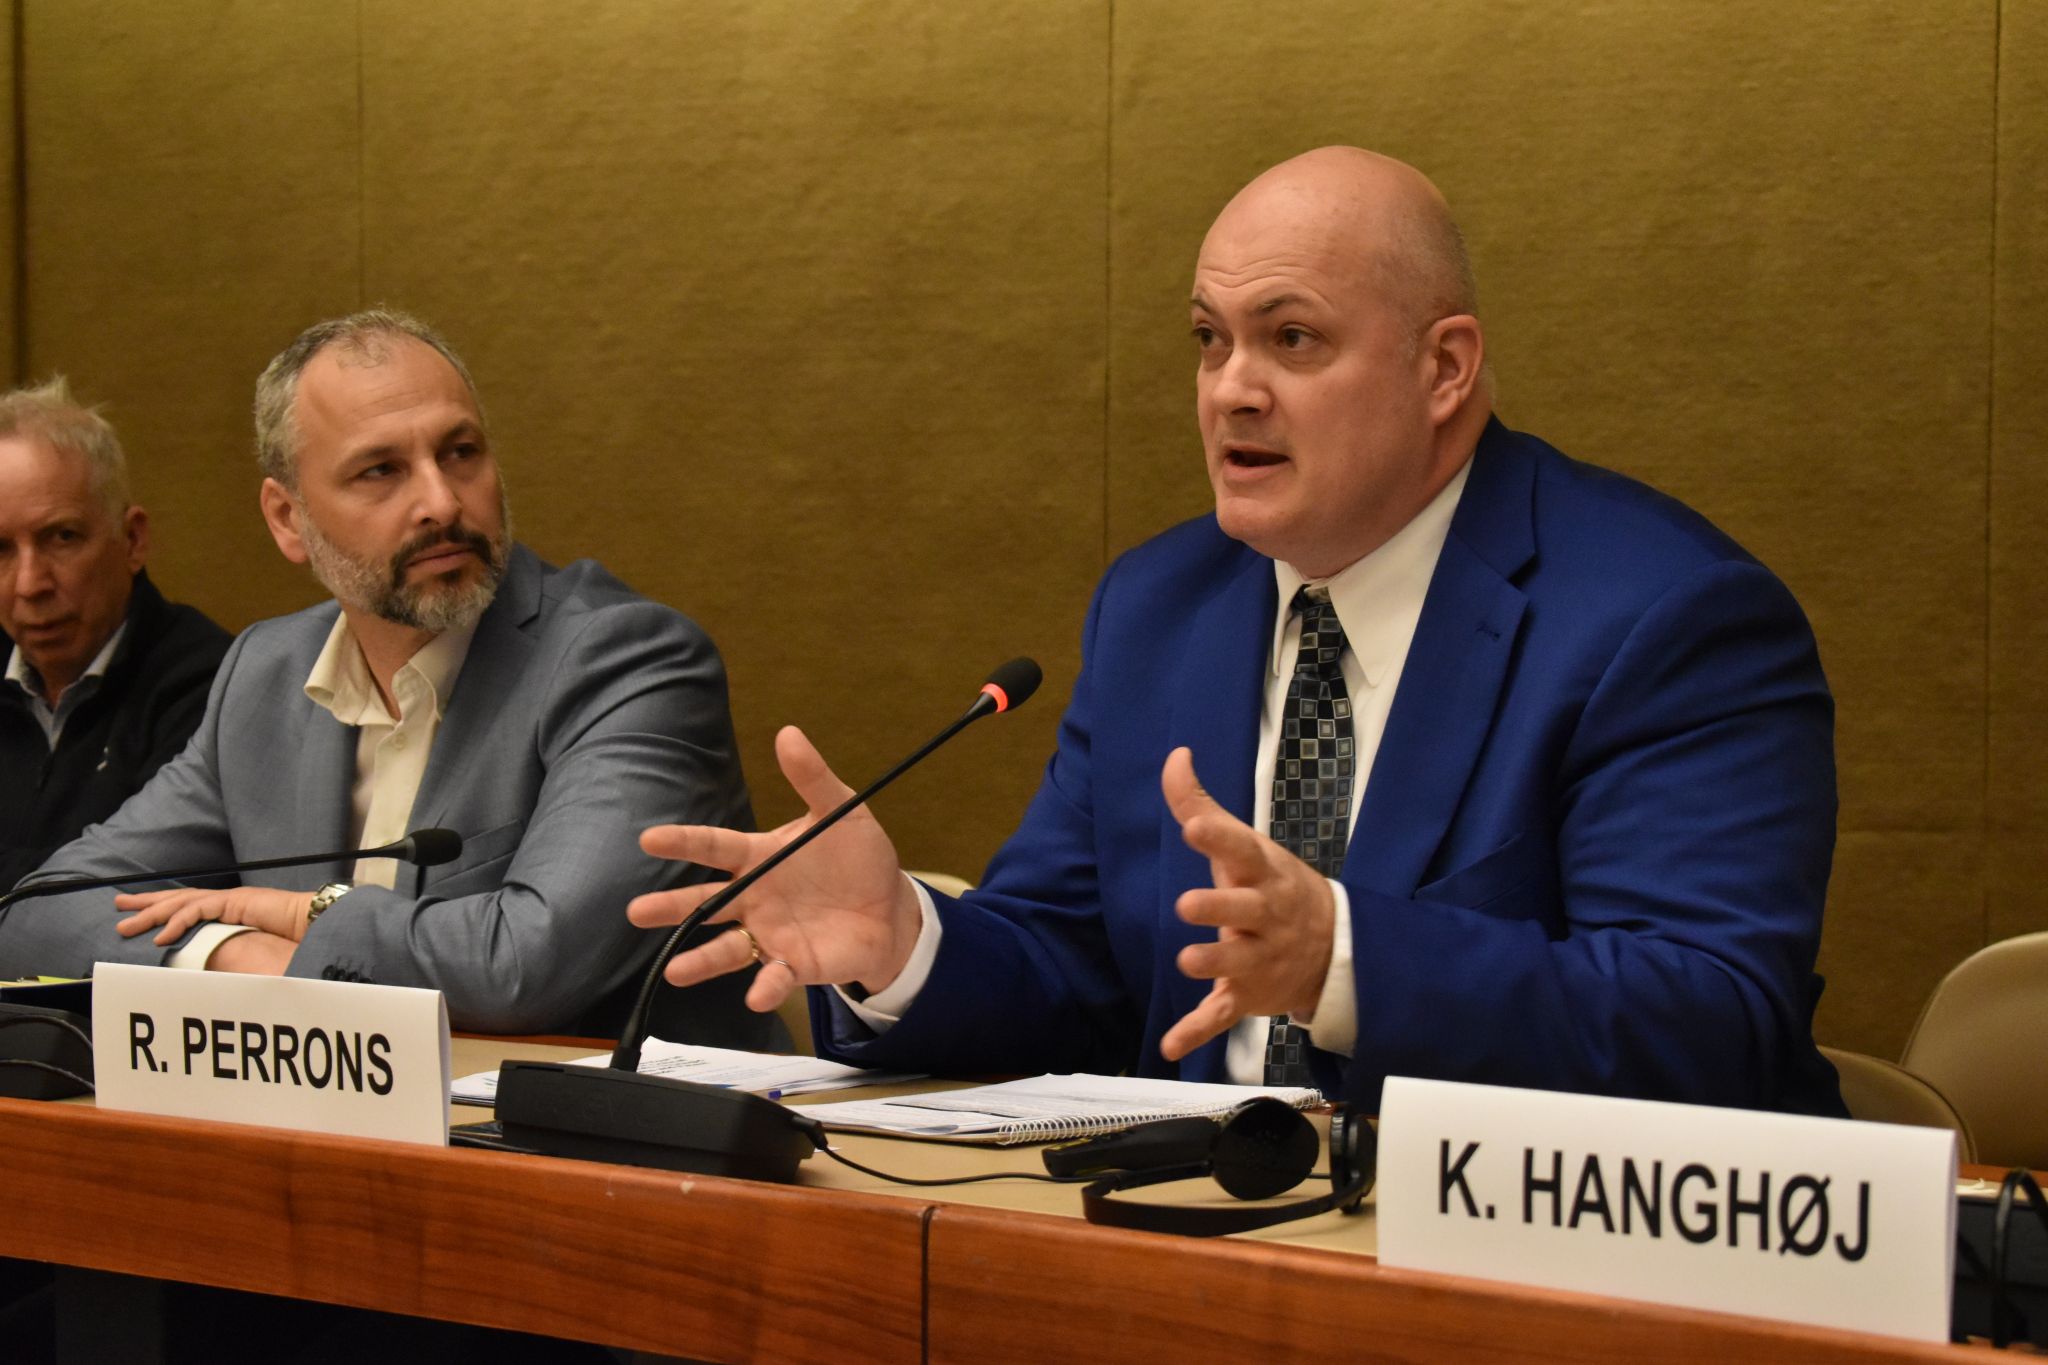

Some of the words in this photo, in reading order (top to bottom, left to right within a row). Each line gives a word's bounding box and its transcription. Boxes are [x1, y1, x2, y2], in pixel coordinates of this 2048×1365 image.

[129, 1012, 169, 1073] R.
[182, 1016, 394, 1096] PERRONS
[1438, 1138, 1497, 1220] K.
[1522, 1147, 1872, 1263] HANGHØJ
